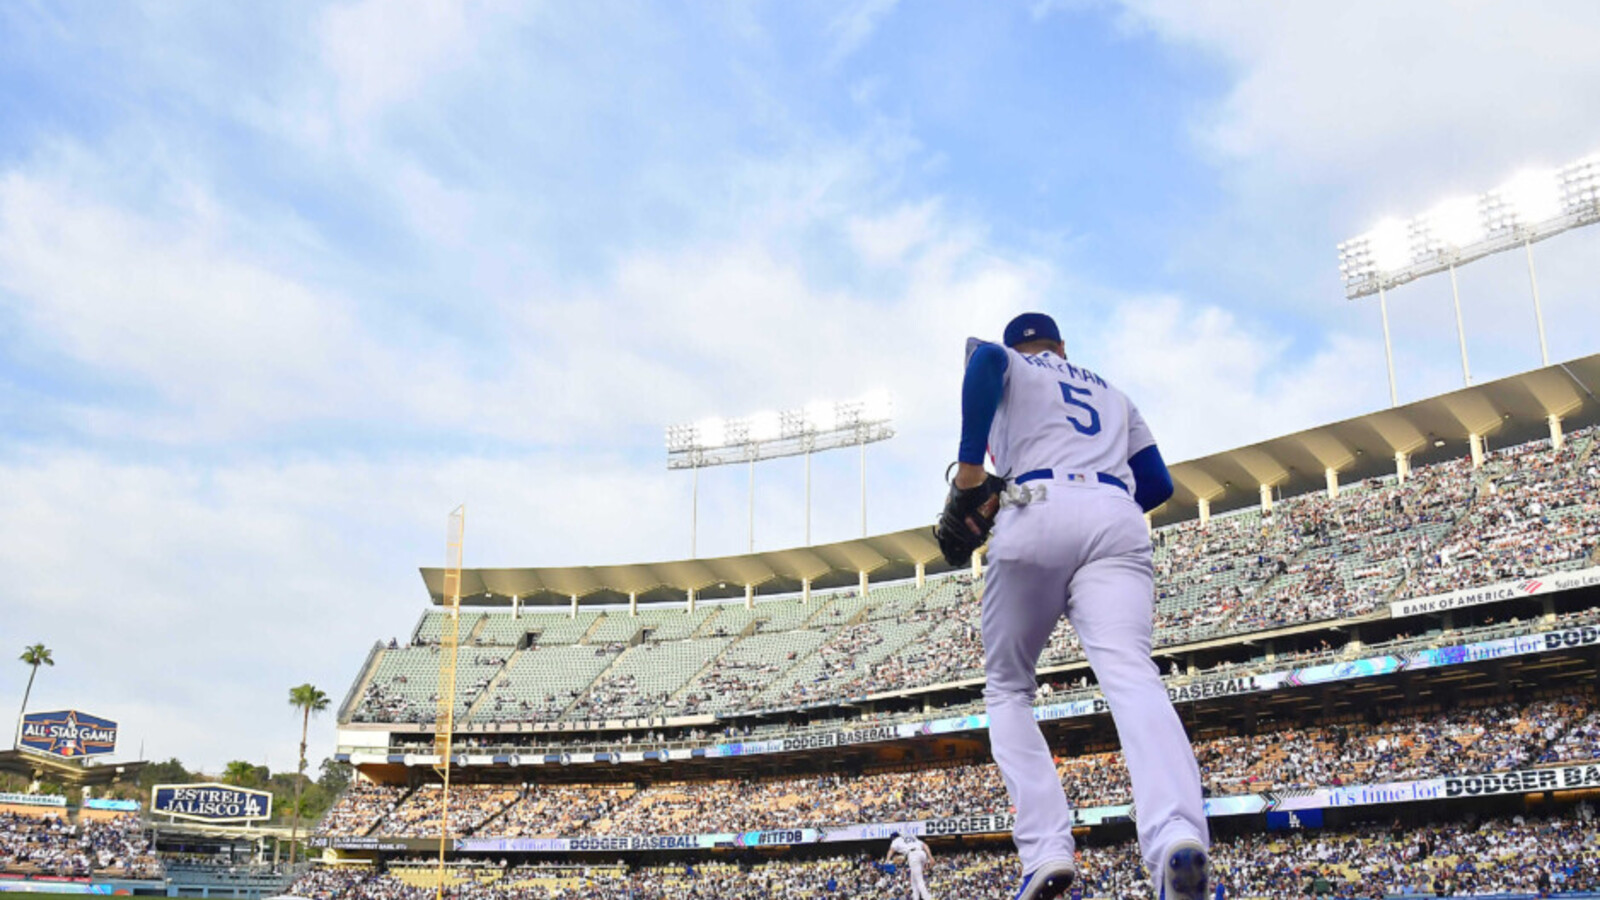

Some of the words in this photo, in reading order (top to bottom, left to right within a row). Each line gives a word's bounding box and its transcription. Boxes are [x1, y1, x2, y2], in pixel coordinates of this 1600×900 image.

[1059, 381, 1101, 436] 5
[1403, 600, 1435, 614] BANK
[1439, 597, 1454, 609] OF
[1458, 589, 1514, 606] AMERICA
[1545, 626, 1600, 649] DOD
[1167, 677, 1261, 702] BASEBALL
[25, 724, 46, 737] ALL
[49, 726, 78, 739] STAR
[80, 728, 115, 742] GAME
[783, 734, 834, 750] DODGER
[837, 726, 901, 746] BASEBALL
[1362, 785, 1405, 803] time
[1412, 781, 1441, 799] for
[1446, 770, 1557, 797] DODGER
[163, 800, 240, 816] JALISCO
[759, 830, 802, 844] #ITFDB
[926, 817, 990, 834] DODGER
[570, 838, 628, 850] DODGER
[632, 836, 700, 849] BASEBALL
